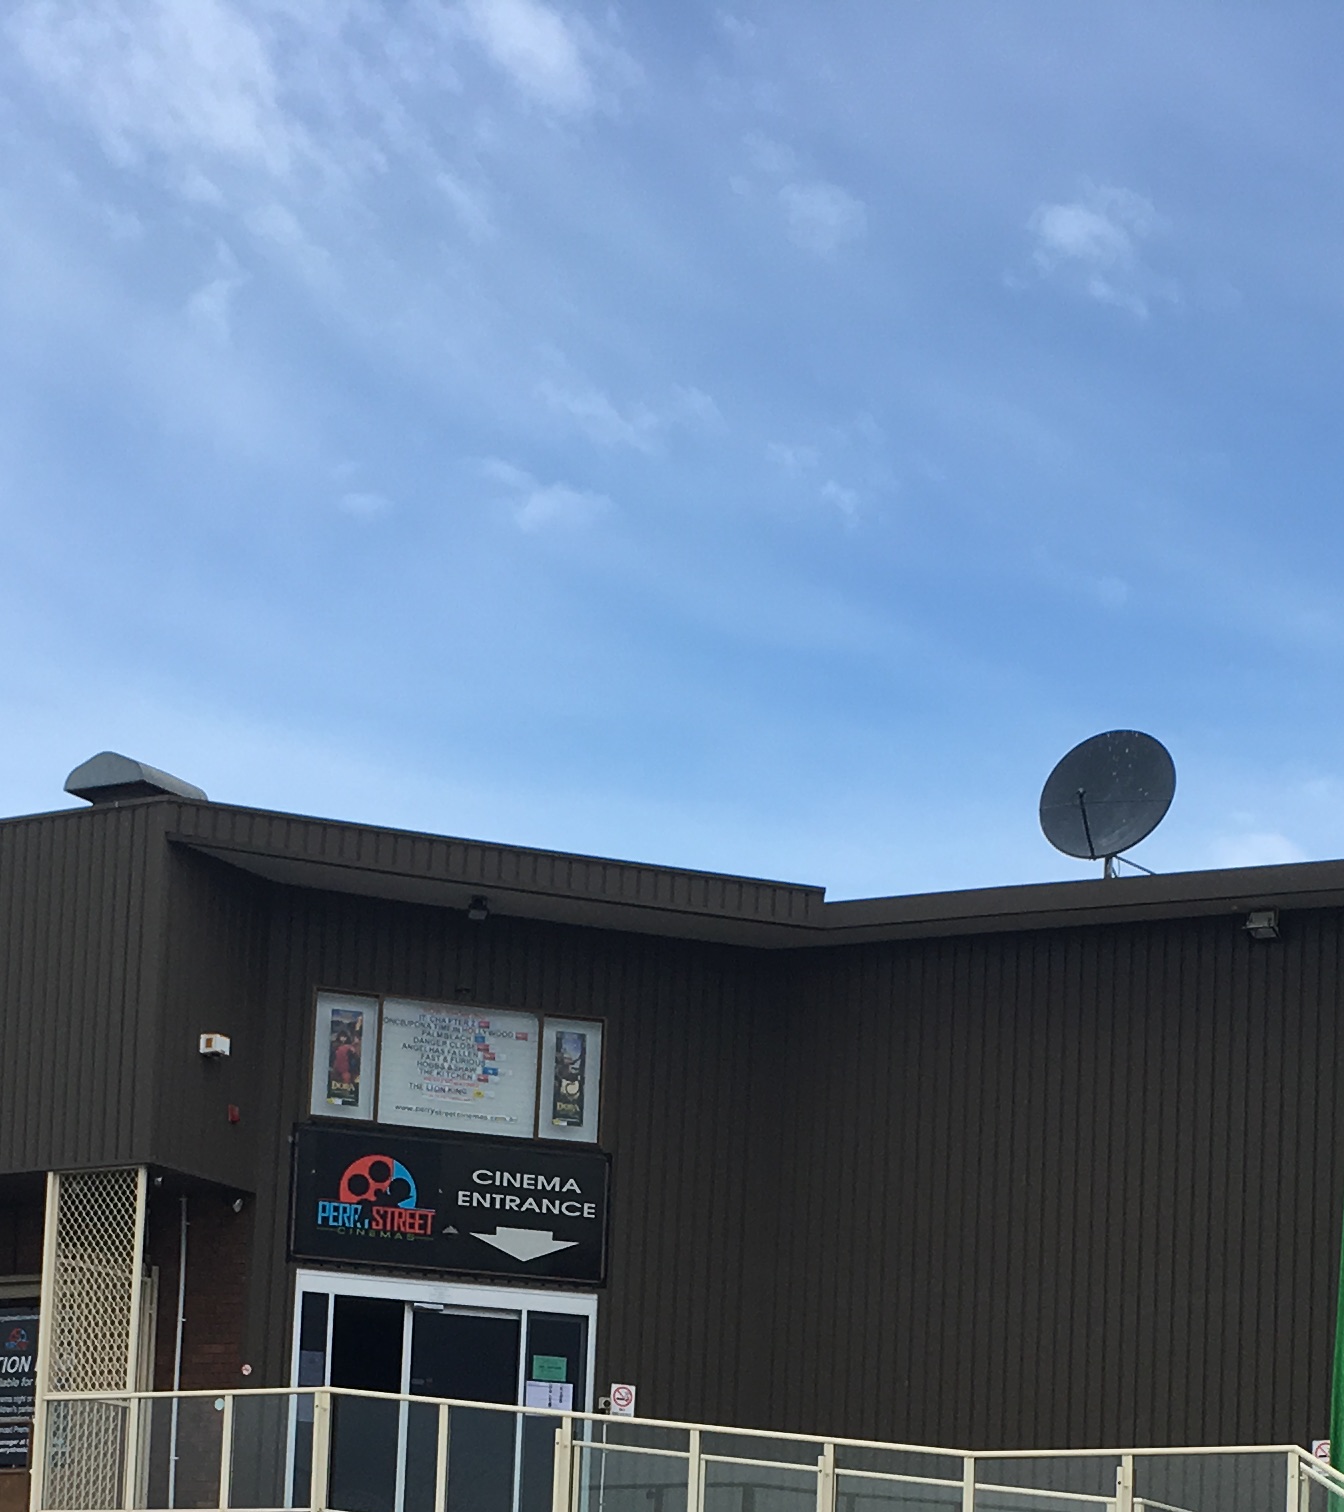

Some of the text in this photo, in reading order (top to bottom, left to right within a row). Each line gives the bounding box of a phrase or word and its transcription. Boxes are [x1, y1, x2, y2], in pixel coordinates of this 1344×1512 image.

[409, 1082, 423, 1090] THE
[472, 1169, 581, 1194] CINEMA
[458, 1190, 596, 1218] ENTRANCE
[317, 1200, 436, 1235] PERR STREET
[337, 1227, 415, 1241] CINEMAS
[21, 1377, 33, 1386] for
